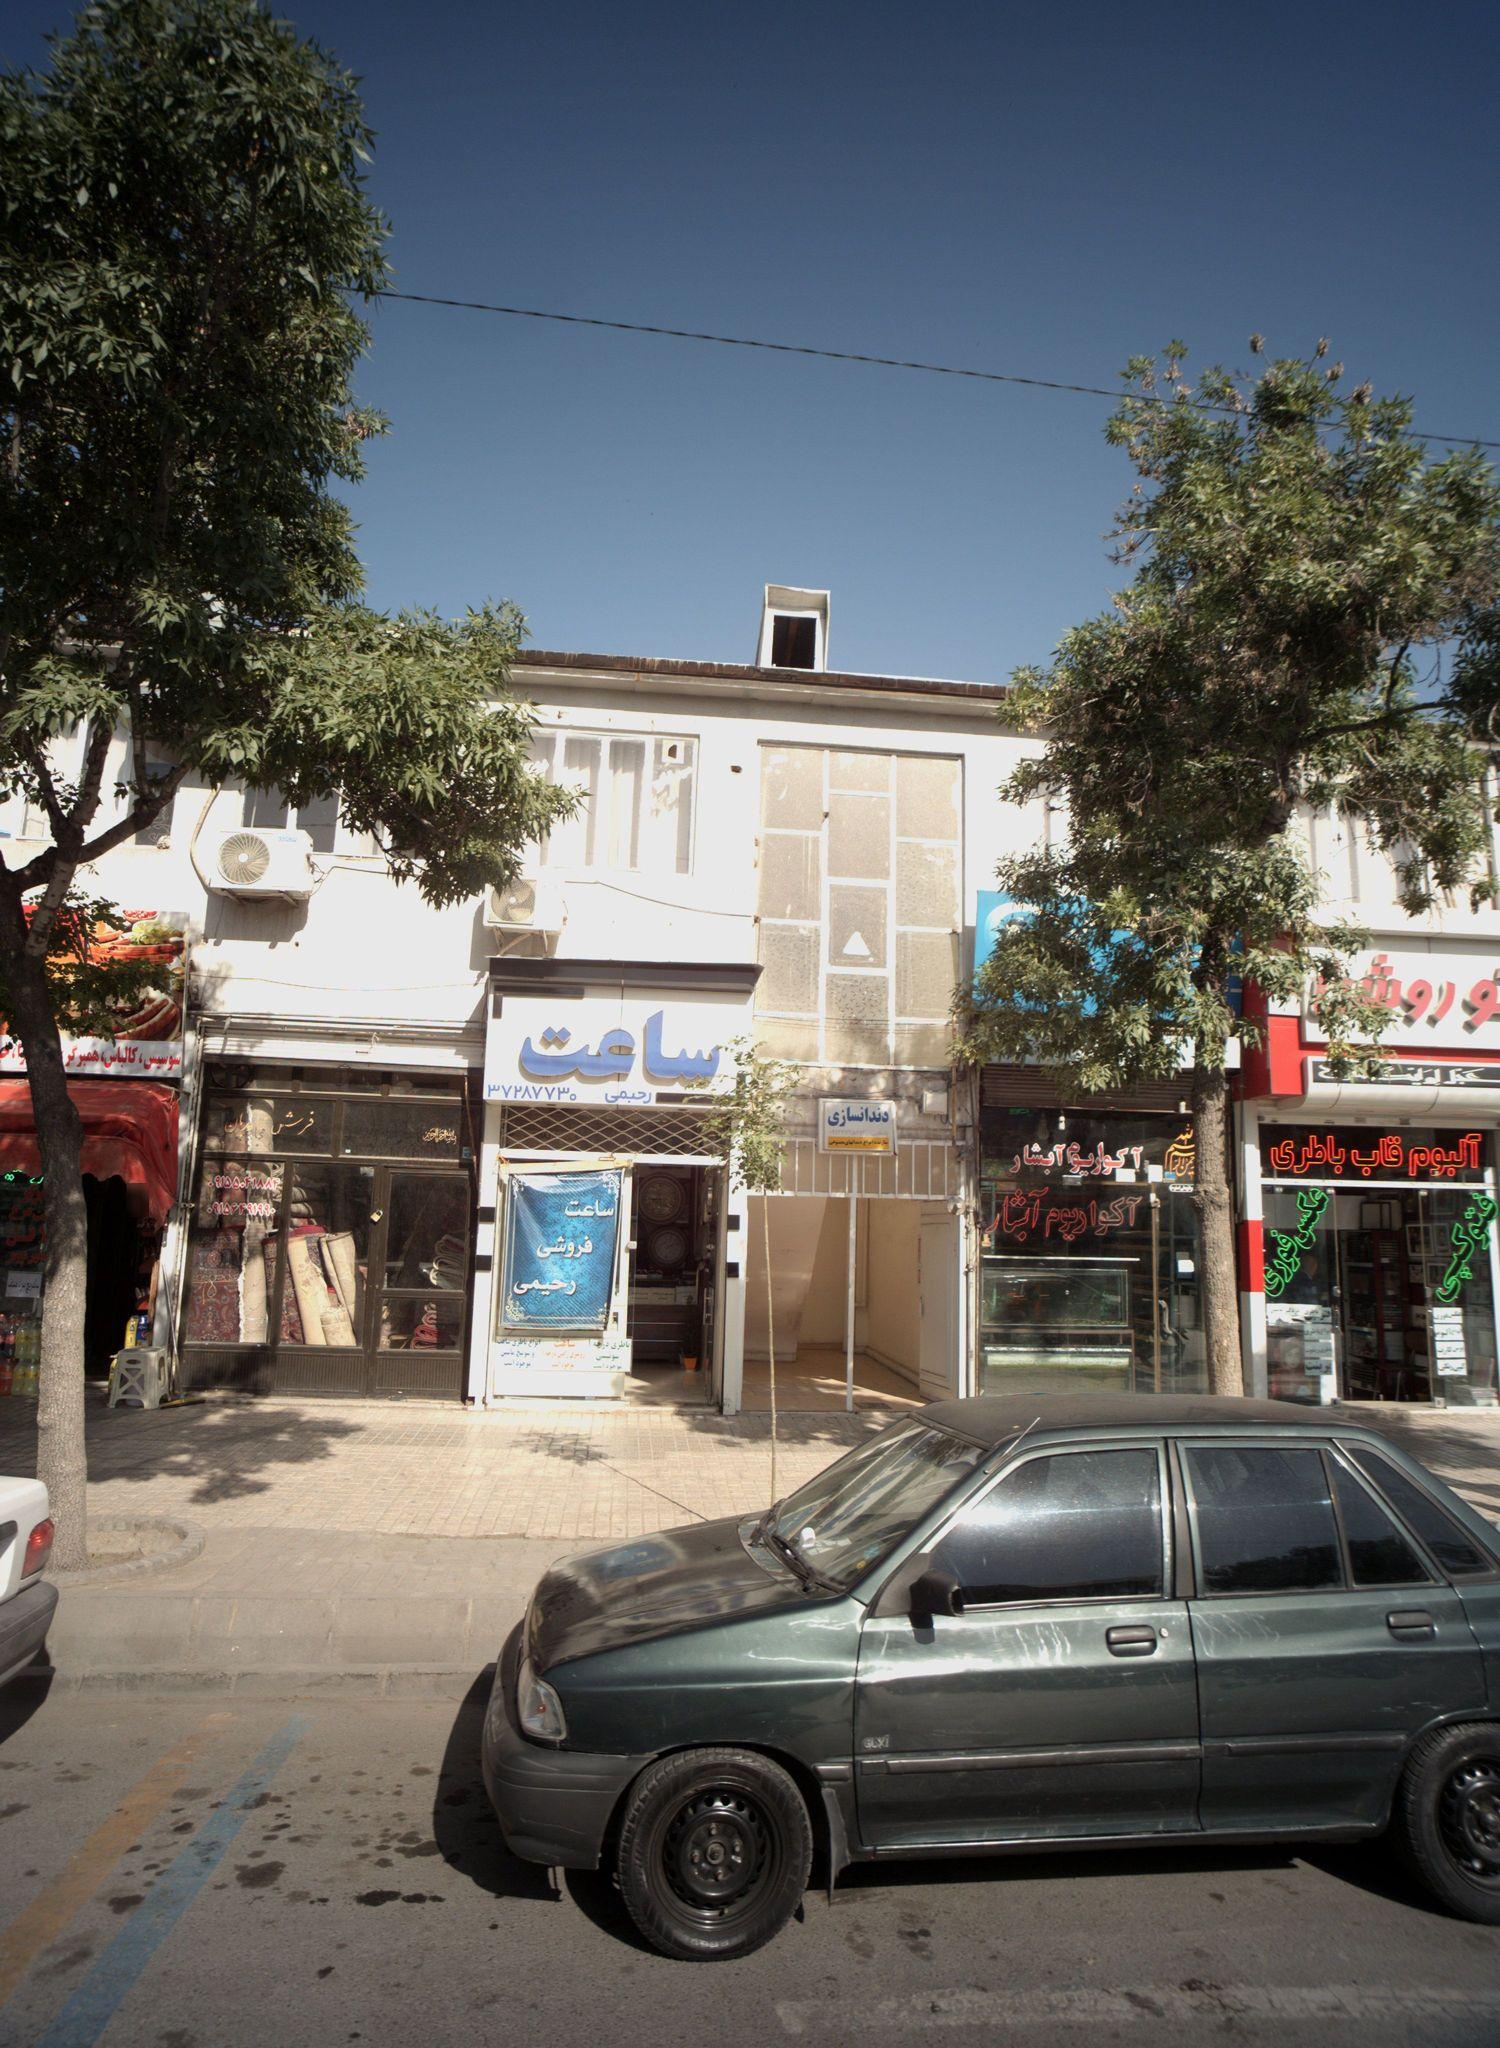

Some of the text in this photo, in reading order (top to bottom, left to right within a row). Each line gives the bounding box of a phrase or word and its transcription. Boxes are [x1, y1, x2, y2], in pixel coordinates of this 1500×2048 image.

[519, 1009, 724, 1083] ساعت
[487, 1084, 652, 1104] رحیمی ۳۷۲۸۷۷۳۰
[827, 1106, 889, 1127] دندانسازی
[1009, 1142, 1067, 1176] آبشار
[1270, 1133, 1483, 1176] آلبوم قاب باطری
[564, 1199, 614, 1217] ساعت
[985, 1186, 1050, 1242] آبشار
[1294, 1188, 1330, 1250] عکس
[536, 1235, 593, 1258] فروشی
[513, 1279, 577, 1296] رحیمی
